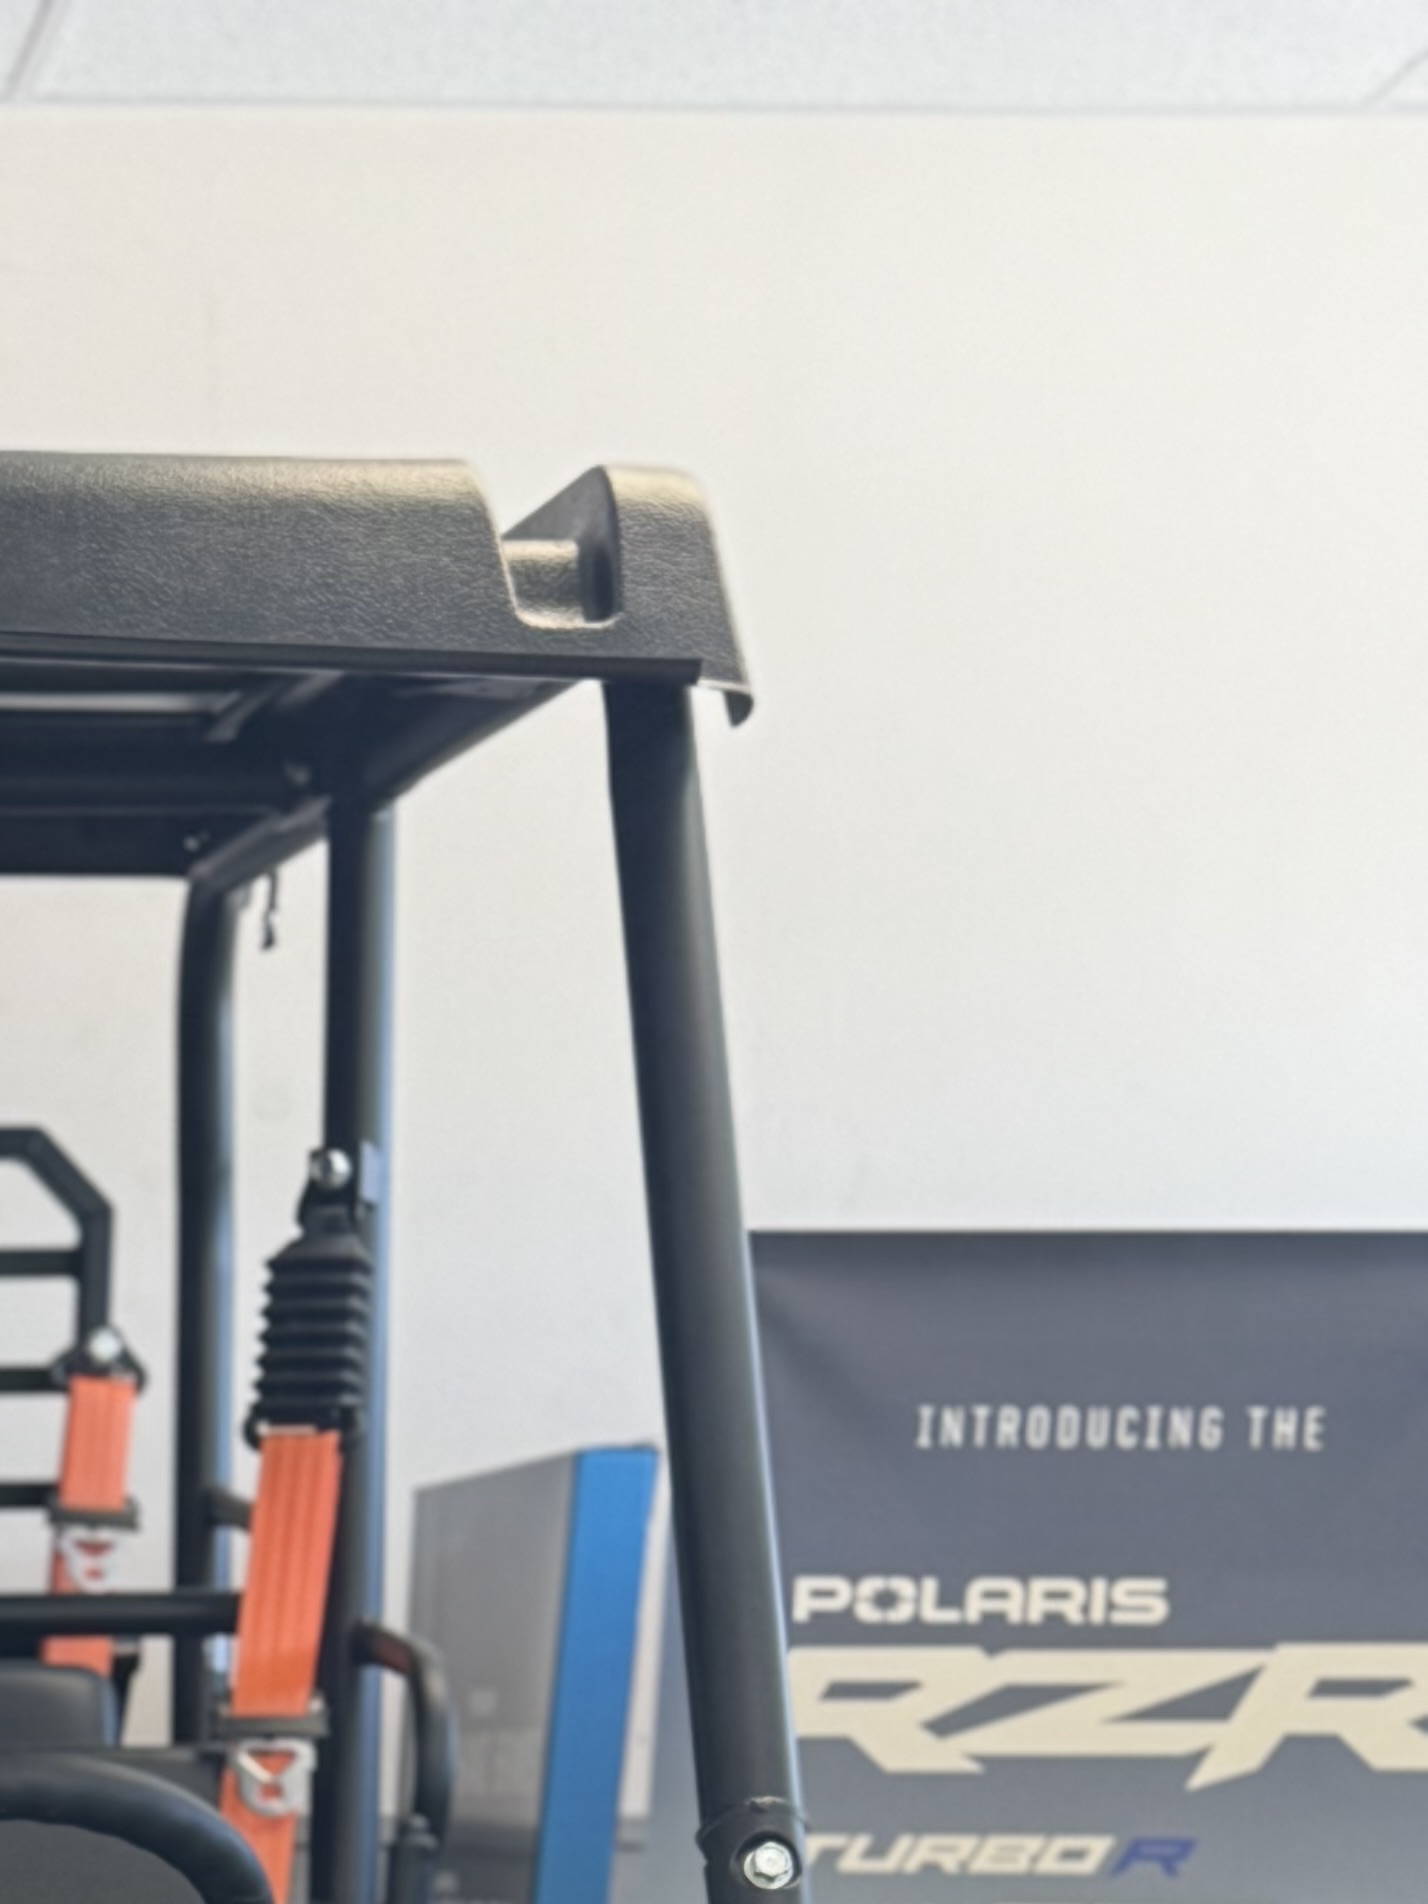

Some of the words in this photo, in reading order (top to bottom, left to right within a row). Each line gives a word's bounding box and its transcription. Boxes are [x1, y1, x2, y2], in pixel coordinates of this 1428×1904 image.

[916, 1405, 1223, 1450] INTRODUCING
[1248, 1406, 1327, 1451] THE
[791, 1575, 1171, 1625] POLARIS
[787, 1643, 1428, 1791] RZR
